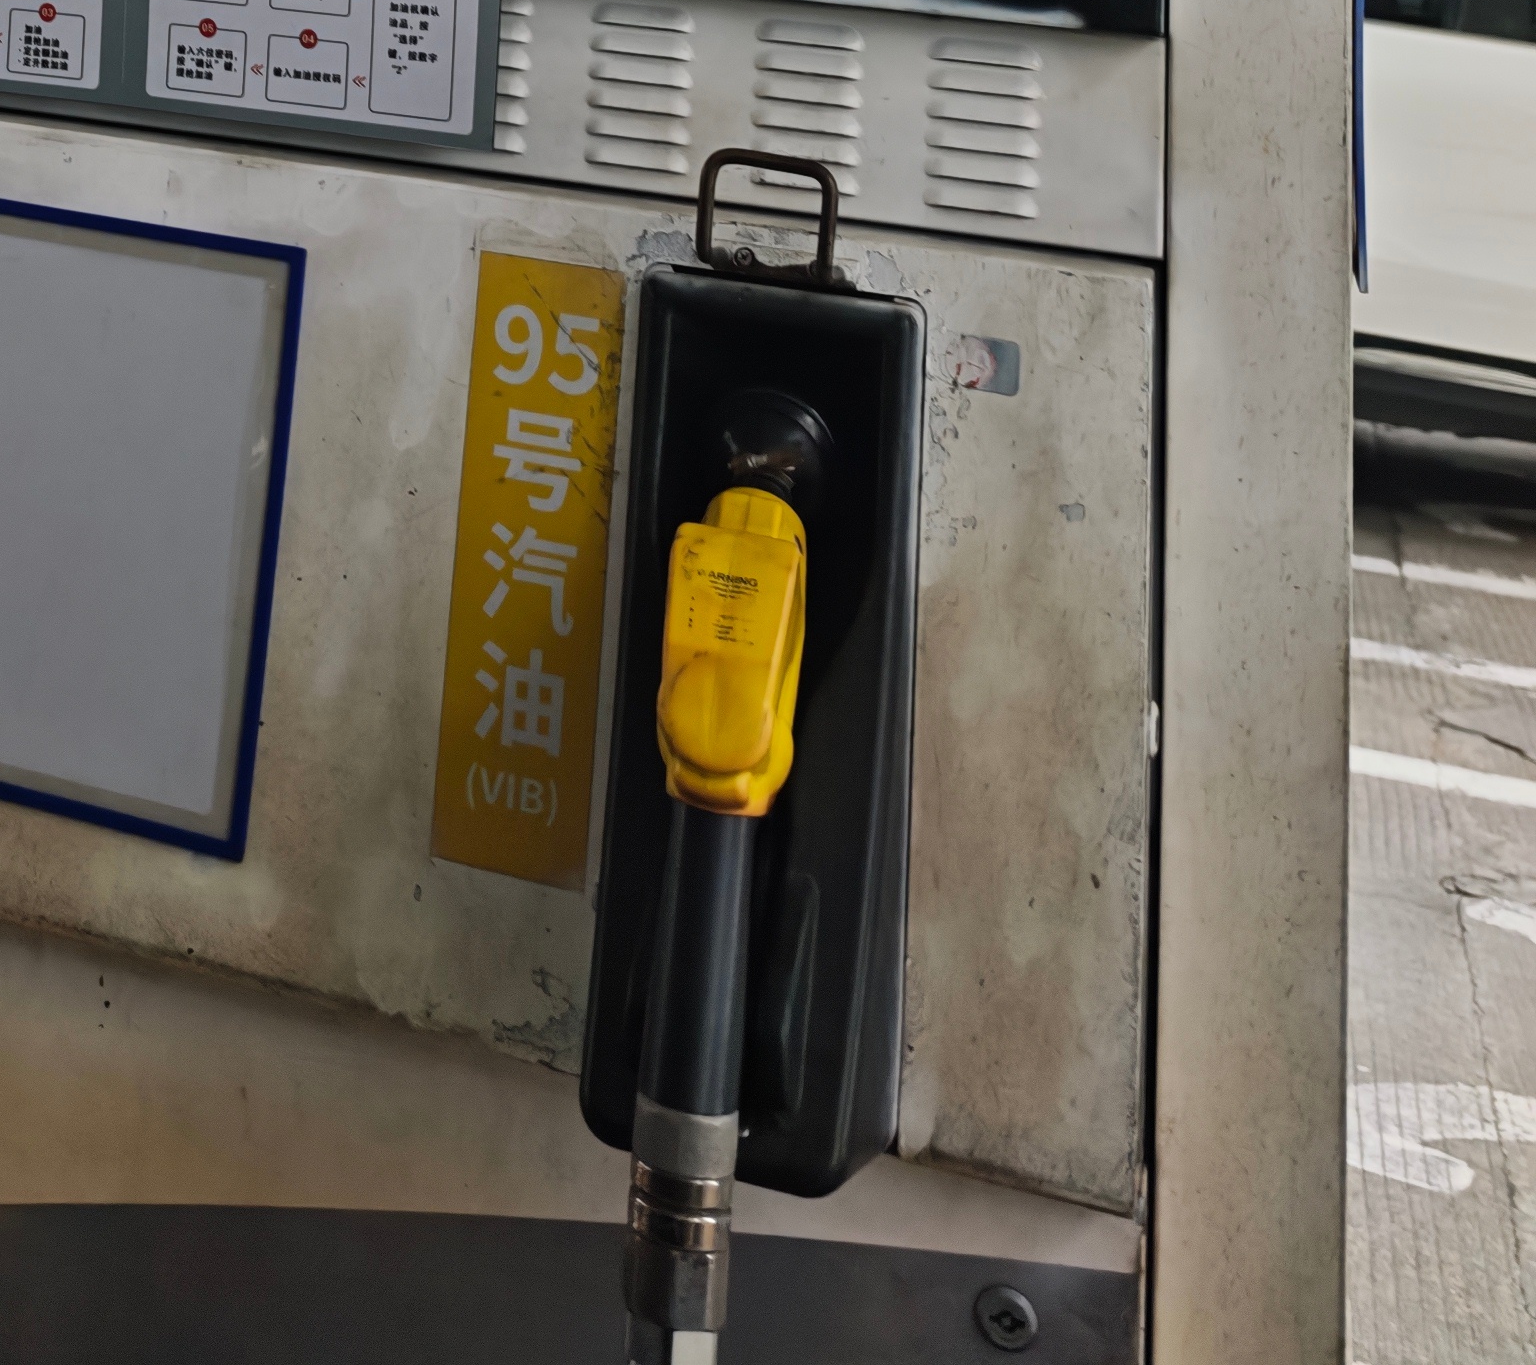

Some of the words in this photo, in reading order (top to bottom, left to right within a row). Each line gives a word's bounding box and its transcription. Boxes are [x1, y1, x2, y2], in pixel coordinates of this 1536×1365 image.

[41, 7, 54, 17] 03
[201, 22, 215, 34] 05
[301, 34, 316, 45] 04
[465, 760, 559, 827] (VIB)
